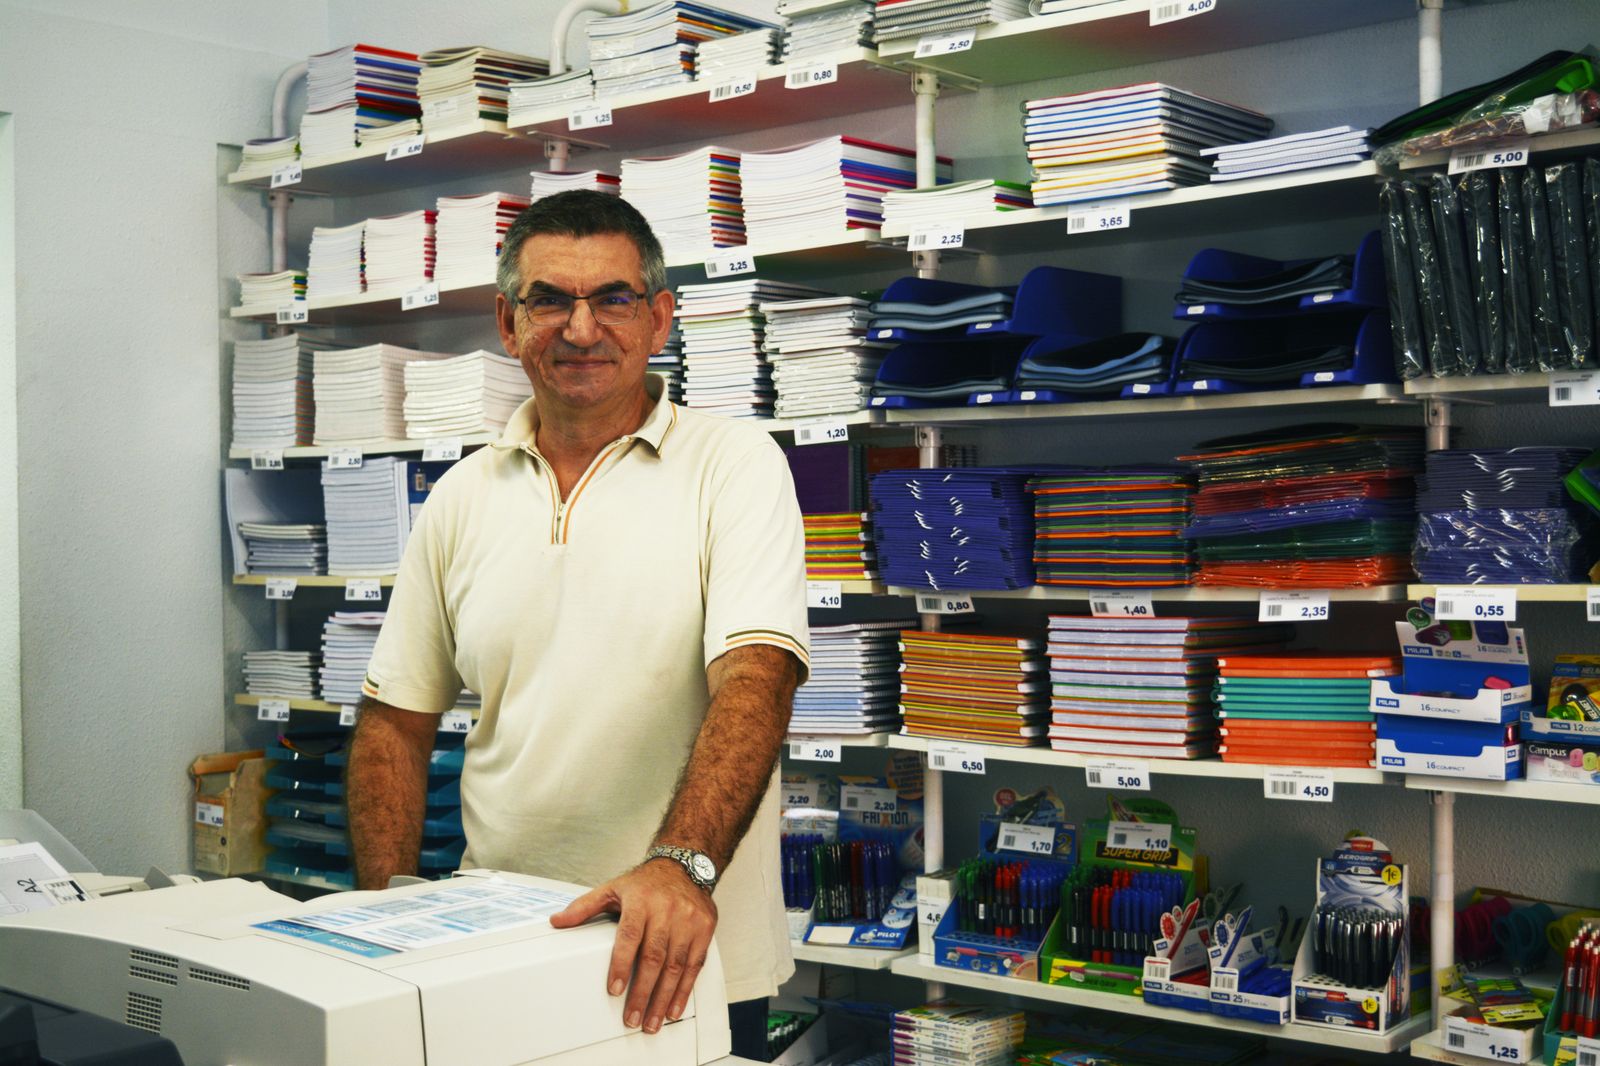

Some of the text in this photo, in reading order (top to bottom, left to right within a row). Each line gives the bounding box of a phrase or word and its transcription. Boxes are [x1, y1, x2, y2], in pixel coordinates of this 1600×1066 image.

[1188, 0, 1212, 12] 4,00
[948, 39, 969, 51] 2,50
[814, 70, 833, 81] 0,80
[734, 83, 752, 95] 0,50
[595, 113, 610, 124] 1,25
[1493, 151, 1522, 163] 5,00
[1100, 215, 1123, 228] 3,65
[941, 234, 962, 245] 2,25
[730, 261, 748, 272] 2,25
[424, 293, 437, 302] 1,25
[827, 427, 845, 439] 1,20
[365, 590, 379, 599] 2,75
[820, 595, 839, 606] 4,10
[947, 601, 969, 611] 0,80
[1123, 605, 1146, 615] 1,40
[1301, 605, 1326, 618] 2,35
[1475, 604, 1504, 618] 0,55
[1406, 646, 1429, 655] MILAN
[1378, 698, 1398, 707] MILAN
[1420, 703, 1431, 712] 16
[1573, 723, 1584, 732] 12
[815, 749, 834, 759] 2,00
[1529, 744, 1567, 757] Campus
[962, 760, 982, 771] 6,50
[1384, 756, 1403, 765] MILAN
[1426, 762, 1436, 770] 16
[1118, 776, 1140, 788] 5,00
[1304, 785, 1329, 798] 4,50
[788, 795, 809, 805] 2,20
[874, 801, 895, 811] 2,20
[1031, 841, 1051, 852] 1,70
[1145, 838, 1168, 849] 1,10
[1102, 846, 1172, 862] SUPER GRIP
[17, 878, 43, 894] A2
[927, 912, 941, 923] 4,6
[877, 931, 901, 939] PILOT
[1165, 983, 1175, 992] 25
[1233, 994, 1243, 1003] 25
[1488, 1044, 1518, 1059] 1,25
